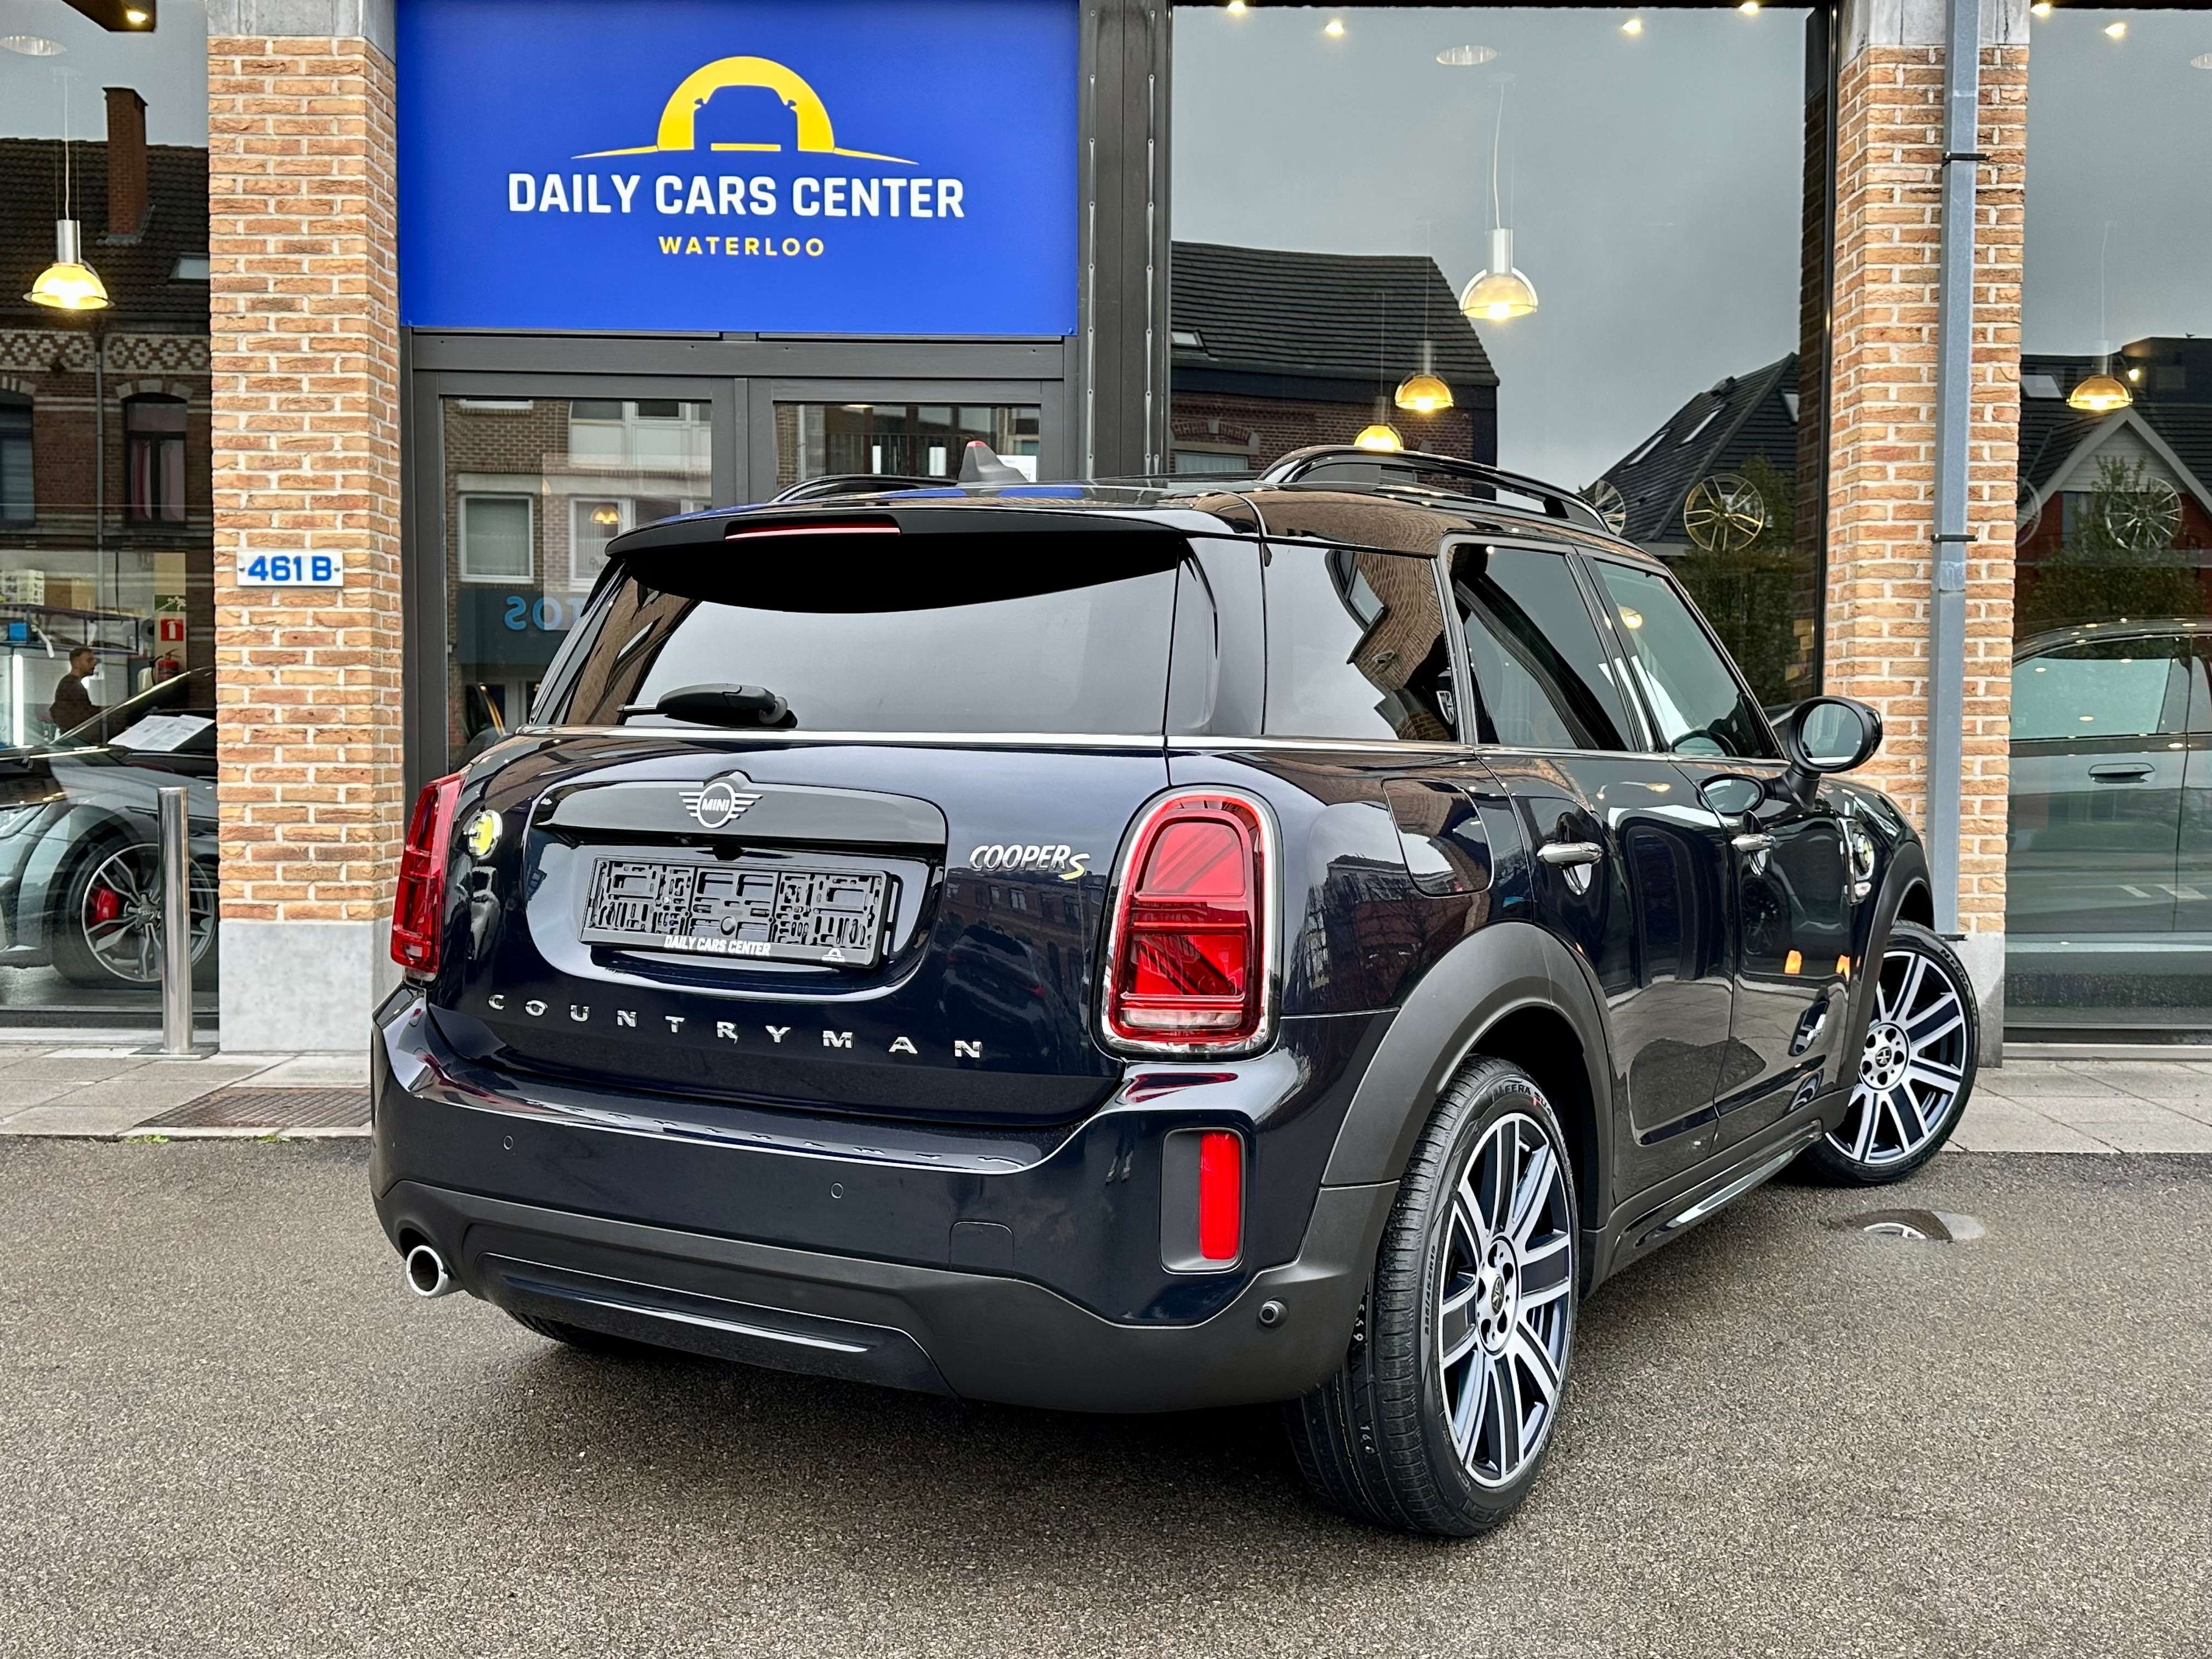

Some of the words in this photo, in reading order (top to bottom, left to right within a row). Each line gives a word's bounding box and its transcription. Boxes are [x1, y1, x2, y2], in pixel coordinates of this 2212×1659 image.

[508, 173, 641, 214] DAILY
[655, 174, 777, 216] CARS
[792, 177, 965, 218] CENTER
[657, 235, 825, 257] WATERLOO
[701, 798, 730, 811] MINI
[663, 934, 695, 950] DAILY
[696, 936, 726, 952] CARS
[727, 939, 771, 956] CENTER
[488, 994, 983, 1059] COUNTRYMAN
